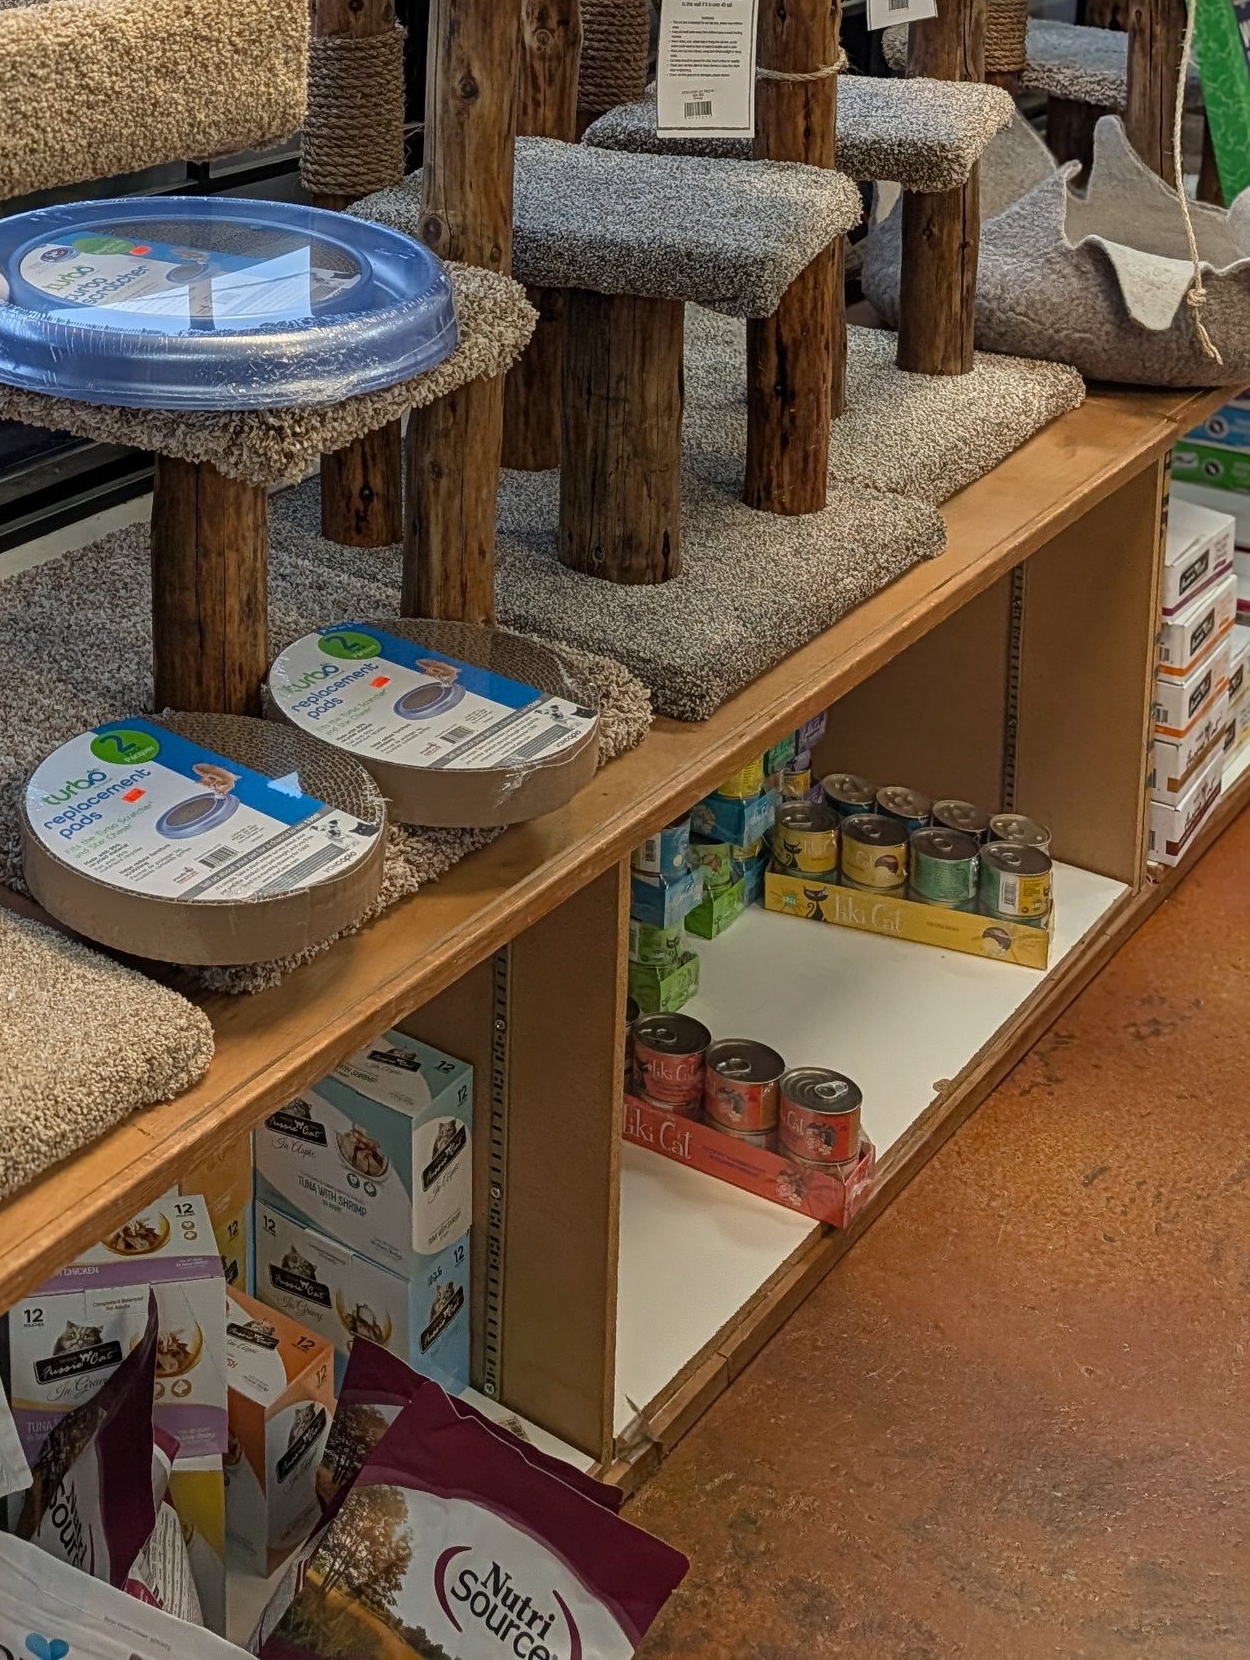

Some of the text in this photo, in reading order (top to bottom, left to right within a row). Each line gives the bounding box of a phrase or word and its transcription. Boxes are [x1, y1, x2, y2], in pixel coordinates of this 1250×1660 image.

[82, 265, 150, 304] scratcher
[292, 662, 379, 713] replacement
[307, 697, 343, 720] pads
[100, 734, 138, 755] 2
[42, 768, 107, 805] turbo
[43, 768, 152, 830] replacement
[59, 810, 103, 840] pads
[870, 902, 903, 933] Cat
[436, 1060, 455, 1072] 12
[457, 1085, 468, 1101] 12
[302, 1125, 321, 1139] Cat
[660, 1121, 692, 1159] Cat
[298, 1176, 367, 1217] TUNA WITH SHRIMP
[174, 1204, 194, 1214] 12
[228, 1220, 239, 1239] 12
[263, 1215, 276, 1234] 12
[453, 1245, 465, 1263] 12
[63, 1266, 99, 1276] CHICKEN
[307, 1285, 326, 1299] Cat
[24, 1309, 44, 1323] 12
[297, 1336, 316, 1351] 12
[43, 1350, 115, 1380] Fussie Cat
[316, 1365, 327, 1385] 12
[27, 1422, 52, 1433] TUNA
[480, 1561, 556, 1640] Nutri
[450, 1569, 551, 1660] Source
